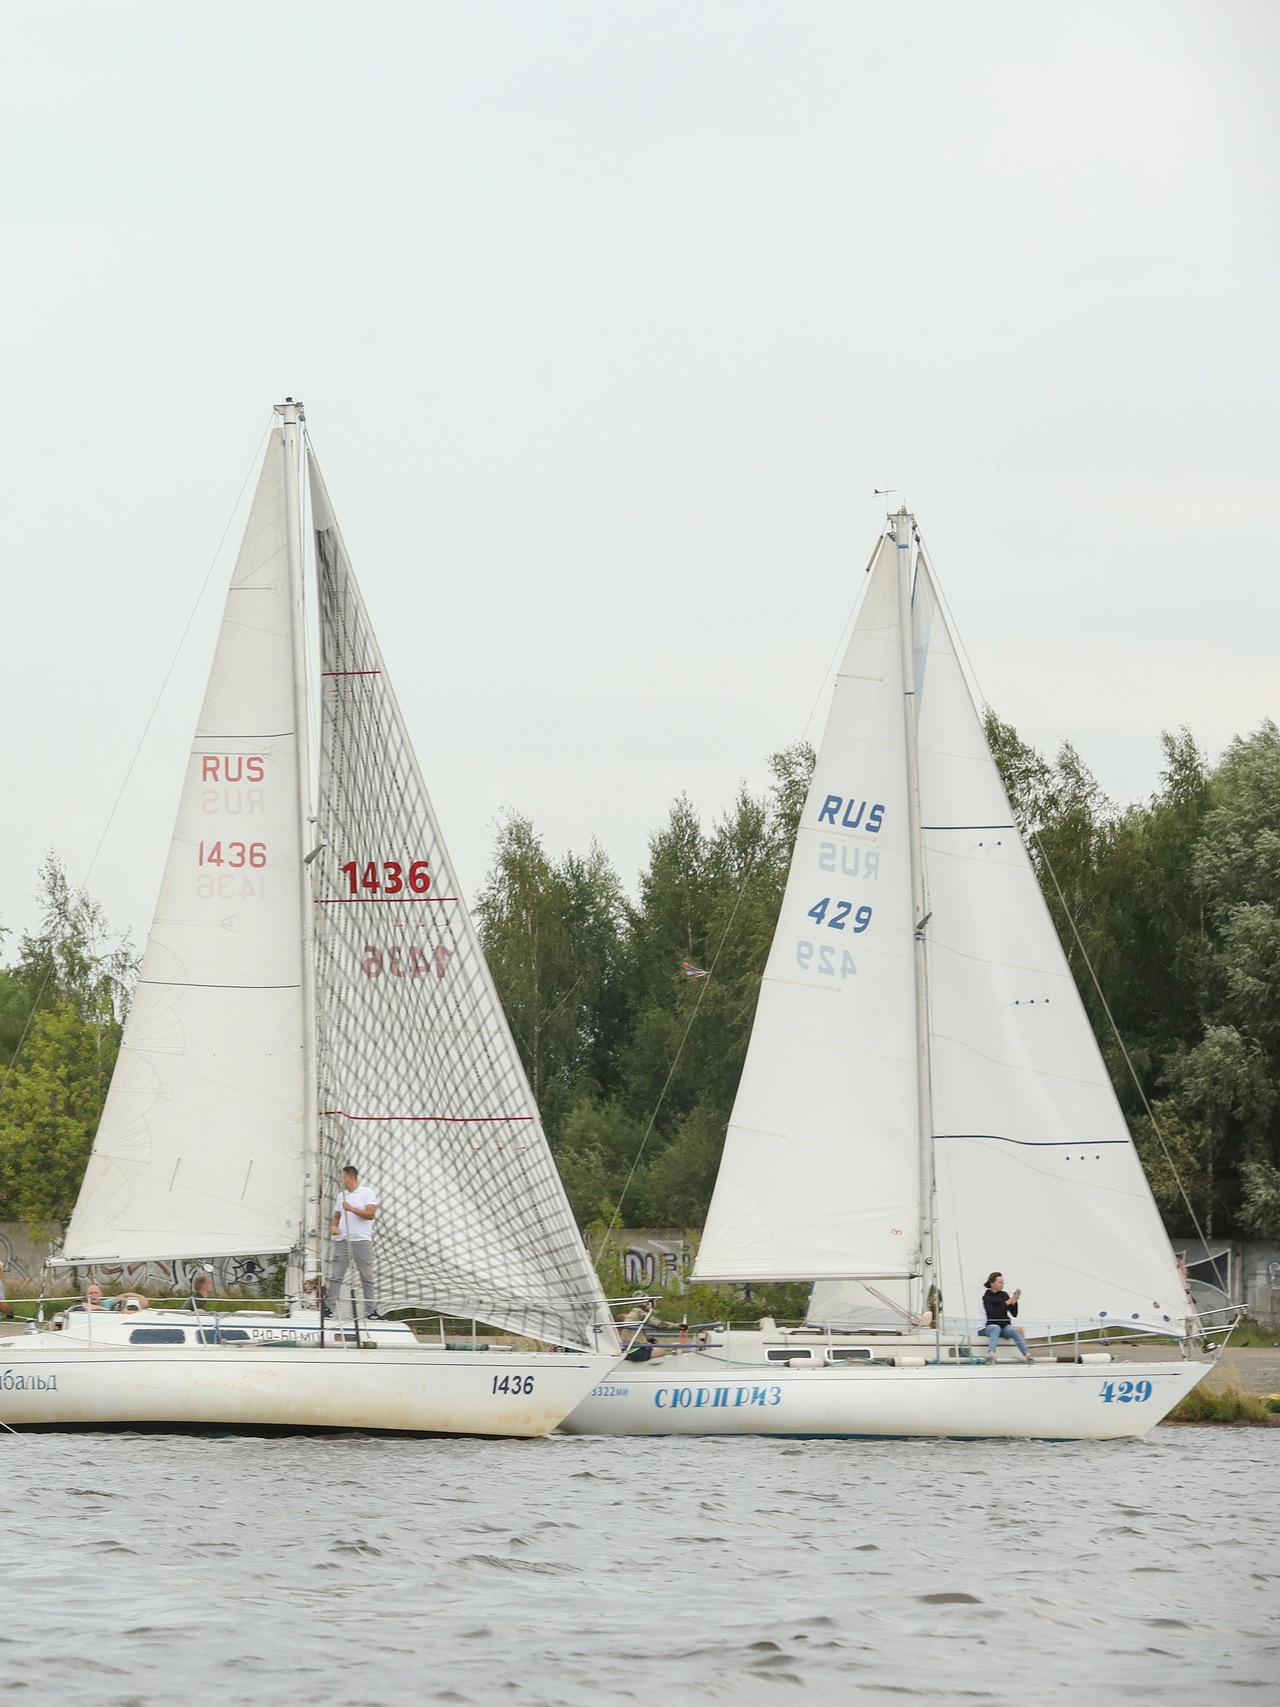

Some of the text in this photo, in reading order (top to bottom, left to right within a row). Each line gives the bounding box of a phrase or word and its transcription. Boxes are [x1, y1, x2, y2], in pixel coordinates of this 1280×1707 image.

[202, 756, 264, 783] RUS
[818, 795, 885, 833] RUS
[198, 841, 267, 868] 1436
[340, 861, 431, 894] 1436
[807, 897, 872, 933] 429
[492, 1375, 535, 1395] 1436
[654, 1386, 782, 1409] СЮРПРИЗ
[1098, 1380, 1152, 1403] 429
